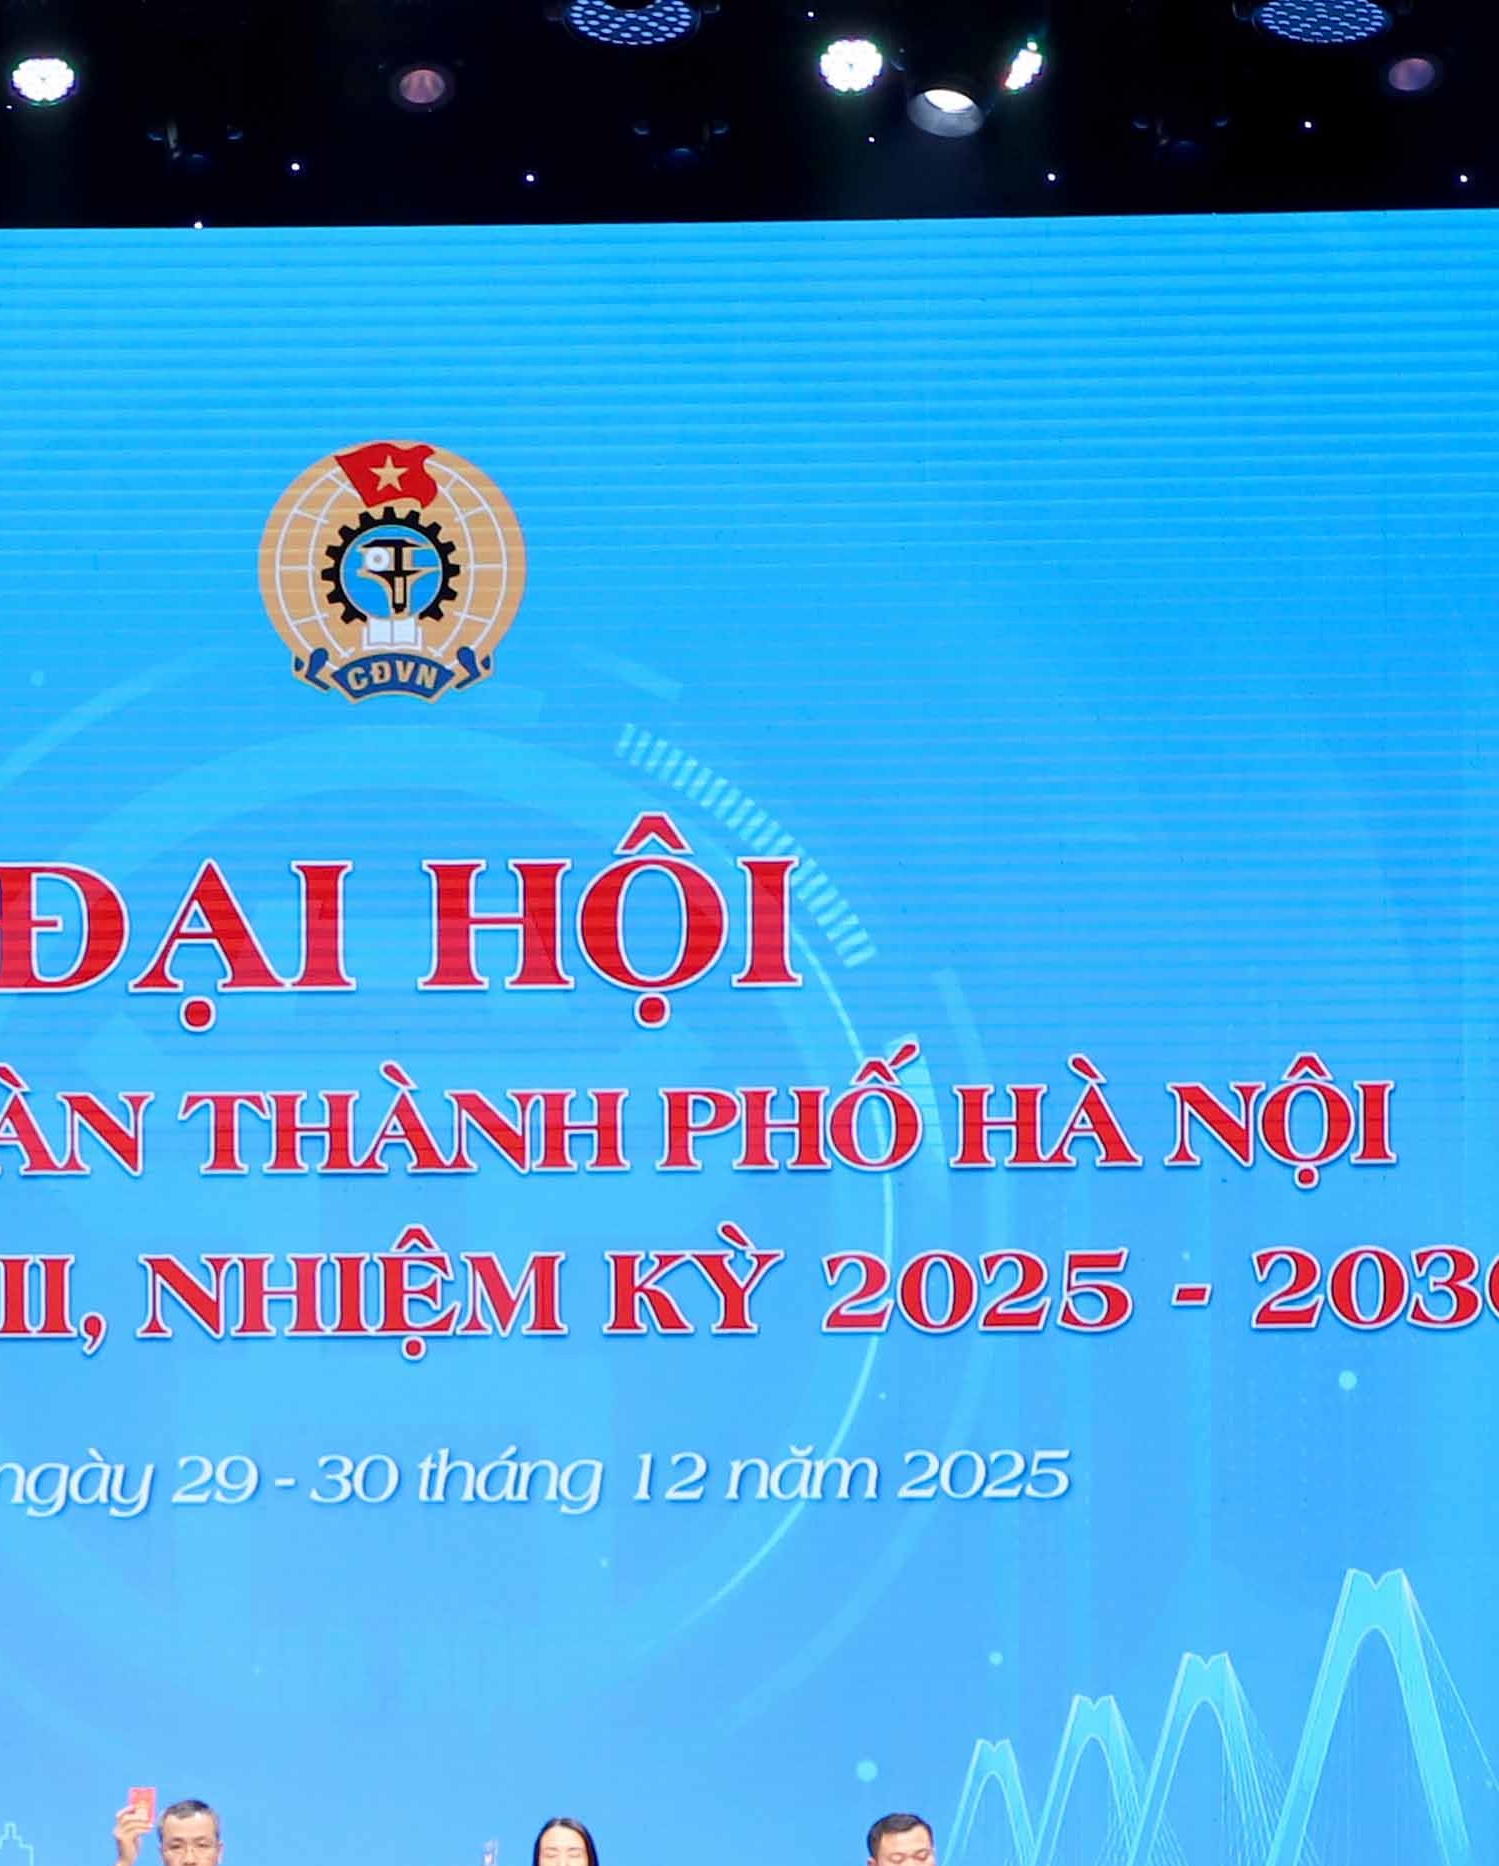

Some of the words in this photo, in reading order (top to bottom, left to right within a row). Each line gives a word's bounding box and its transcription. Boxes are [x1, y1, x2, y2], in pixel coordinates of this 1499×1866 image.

[346, 659, 440, 692] CĐVN
[425, 812, 798, 1027] HỘI
[183, 1062, 623, 1174] THÀNH
[663, 1042, 923, 1169] PHỐ
[956, 1056, 1138, 1167] HÀ
[1171, 1052, 1397, 1189] NỘI
[143, 1224, 563, 1360] NHIỆM
[609, 1222, 777, 1334] KỲ
[825, 1250, 1133, 1332] 2025
[1175, 1284, 1209, 1304] -
[170, 1455, 260, 1504] 29
[308, 1455, 400, 1503] 30
[416, 1446, 605, 1514] tháng
[634, 1453, 708, 1501] 12
[724, 1446, 880, 1501] năm
[896, 1449, 1071, 1500] 2025
